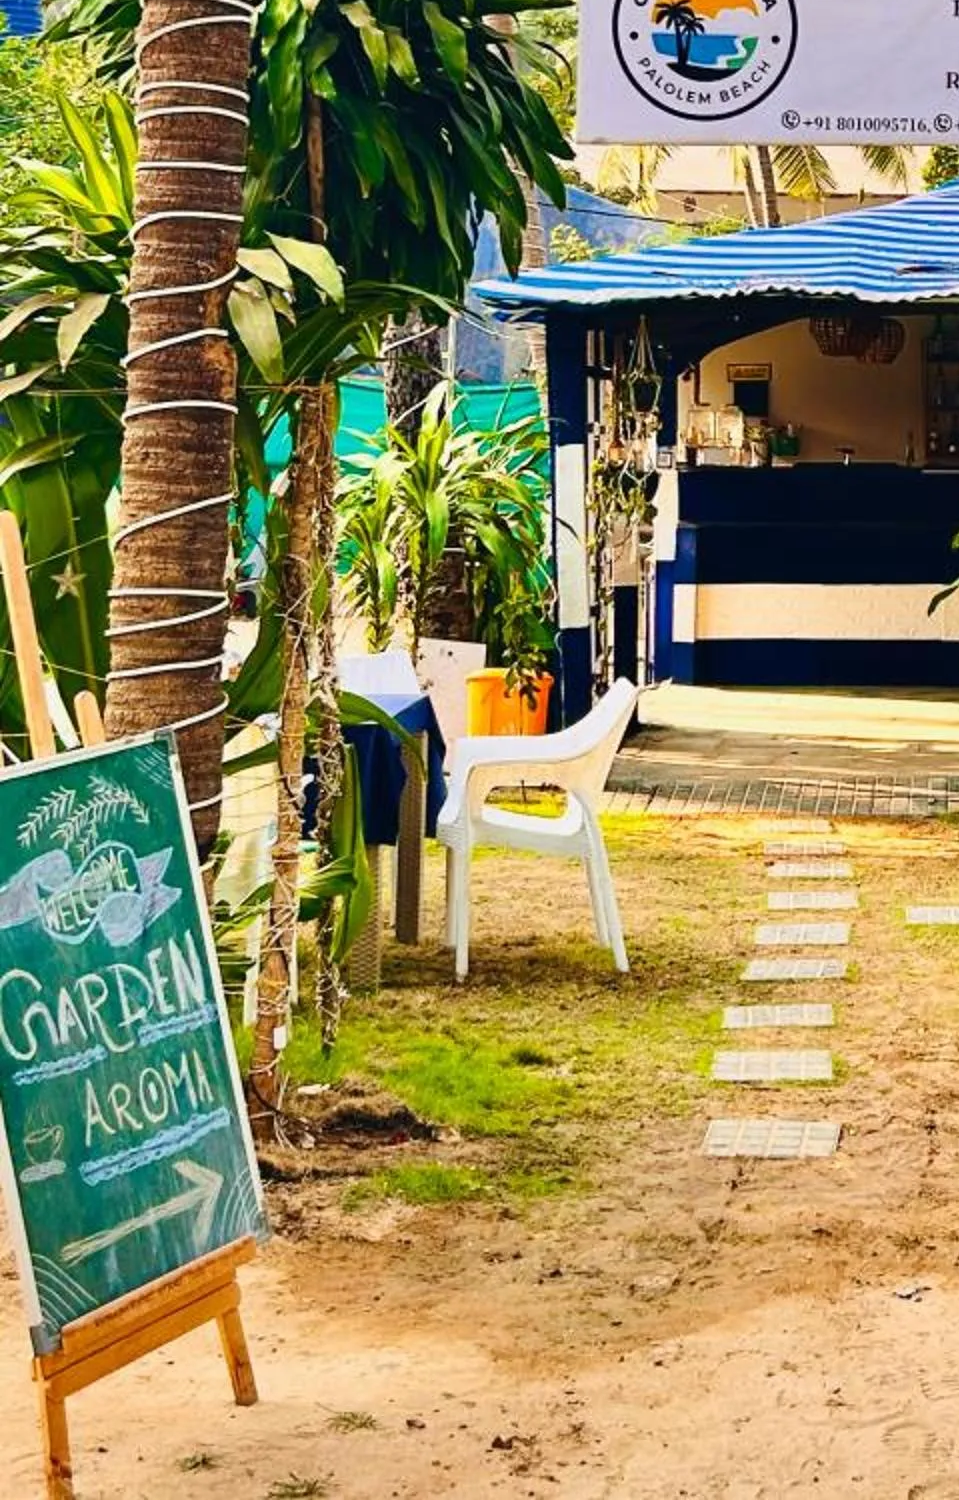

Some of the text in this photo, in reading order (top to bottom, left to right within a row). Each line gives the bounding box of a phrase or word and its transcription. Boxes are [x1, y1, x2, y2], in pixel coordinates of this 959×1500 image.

[638, 57, 772, 104] PALOLEM BEACH
[802, 116, 832, 131] +91
[40, 847, 137, 932] WELCOME
[0, 929, 207, 1060] GARDEN
[85, 1049, 214, 1147] AROMA
